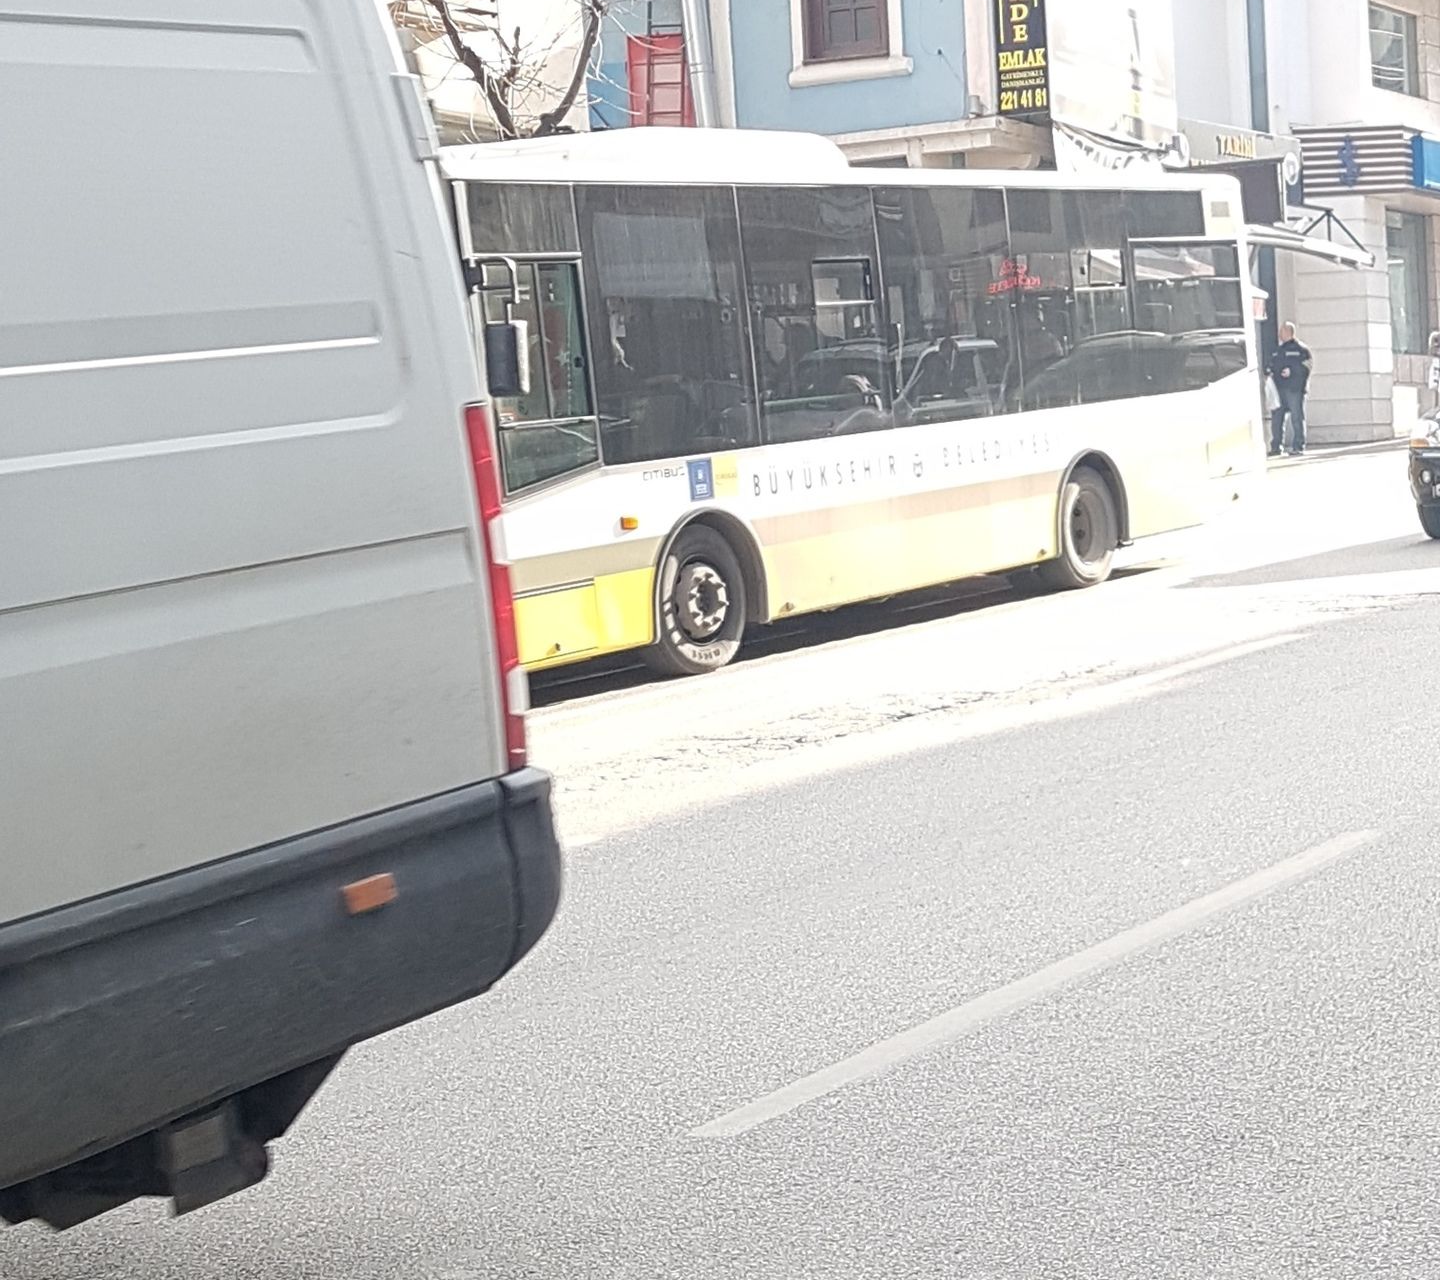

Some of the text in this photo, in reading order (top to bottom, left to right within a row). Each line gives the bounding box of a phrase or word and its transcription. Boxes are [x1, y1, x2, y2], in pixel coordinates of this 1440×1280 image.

[998, 47, 1047, 72] EMLAK
[1001, 87, 1048, 111] 221 41 81
